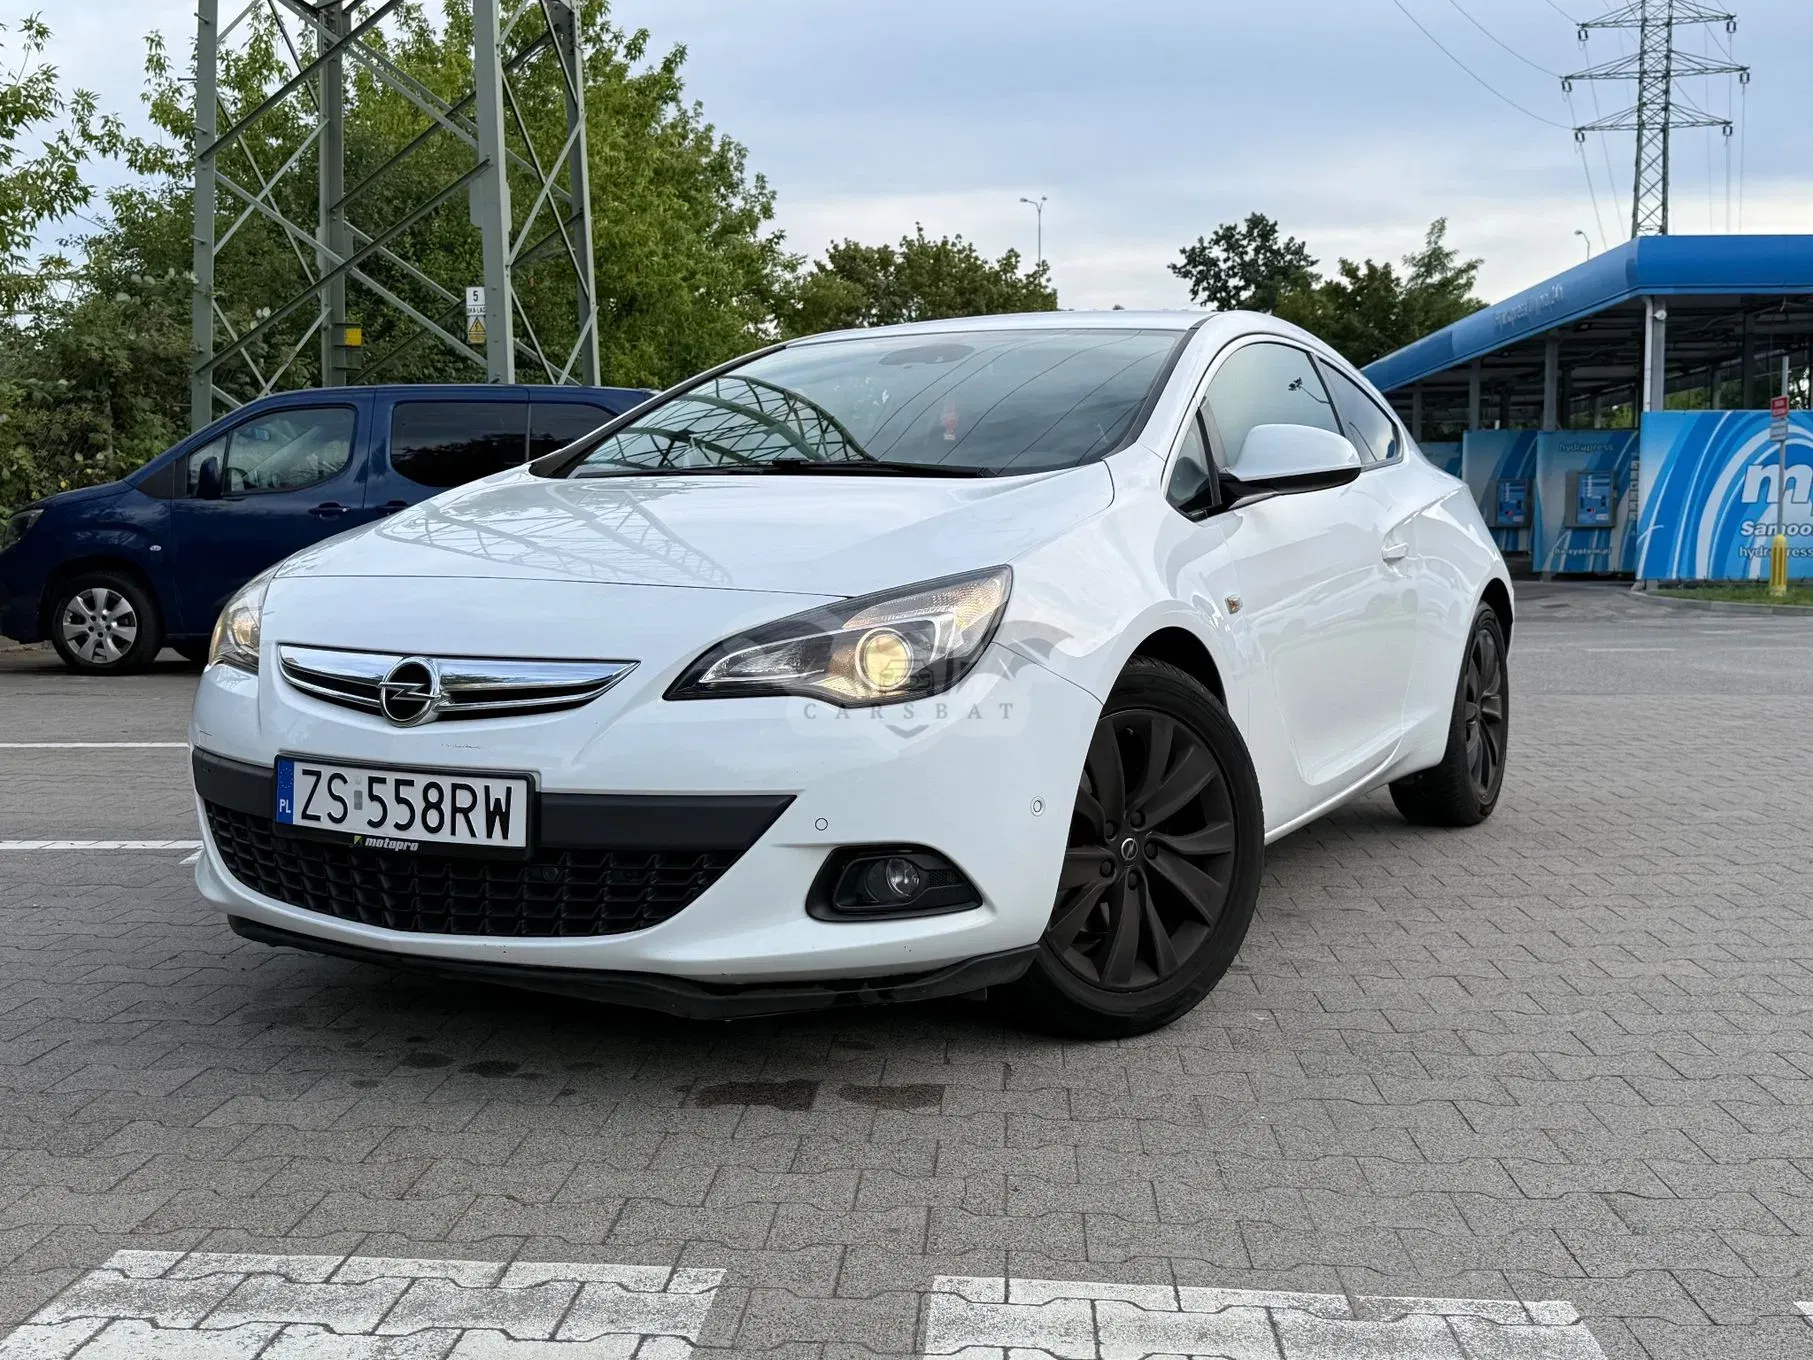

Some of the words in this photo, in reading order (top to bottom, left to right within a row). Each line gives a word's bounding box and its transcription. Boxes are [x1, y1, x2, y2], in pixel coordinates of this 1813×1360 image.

[473, 290, 479, 302] 5
[1740, 463, 1813, 504] m
[1740, 520, 1813, 536] Samoo
[1739, 546, 1813, 559] hydrress
[279, 798, 292, 814] PL
[300, 768, 349, 824] ZS
[366, 775, 513, 840] 558RW
[364, 837, 420, 852] motopro
